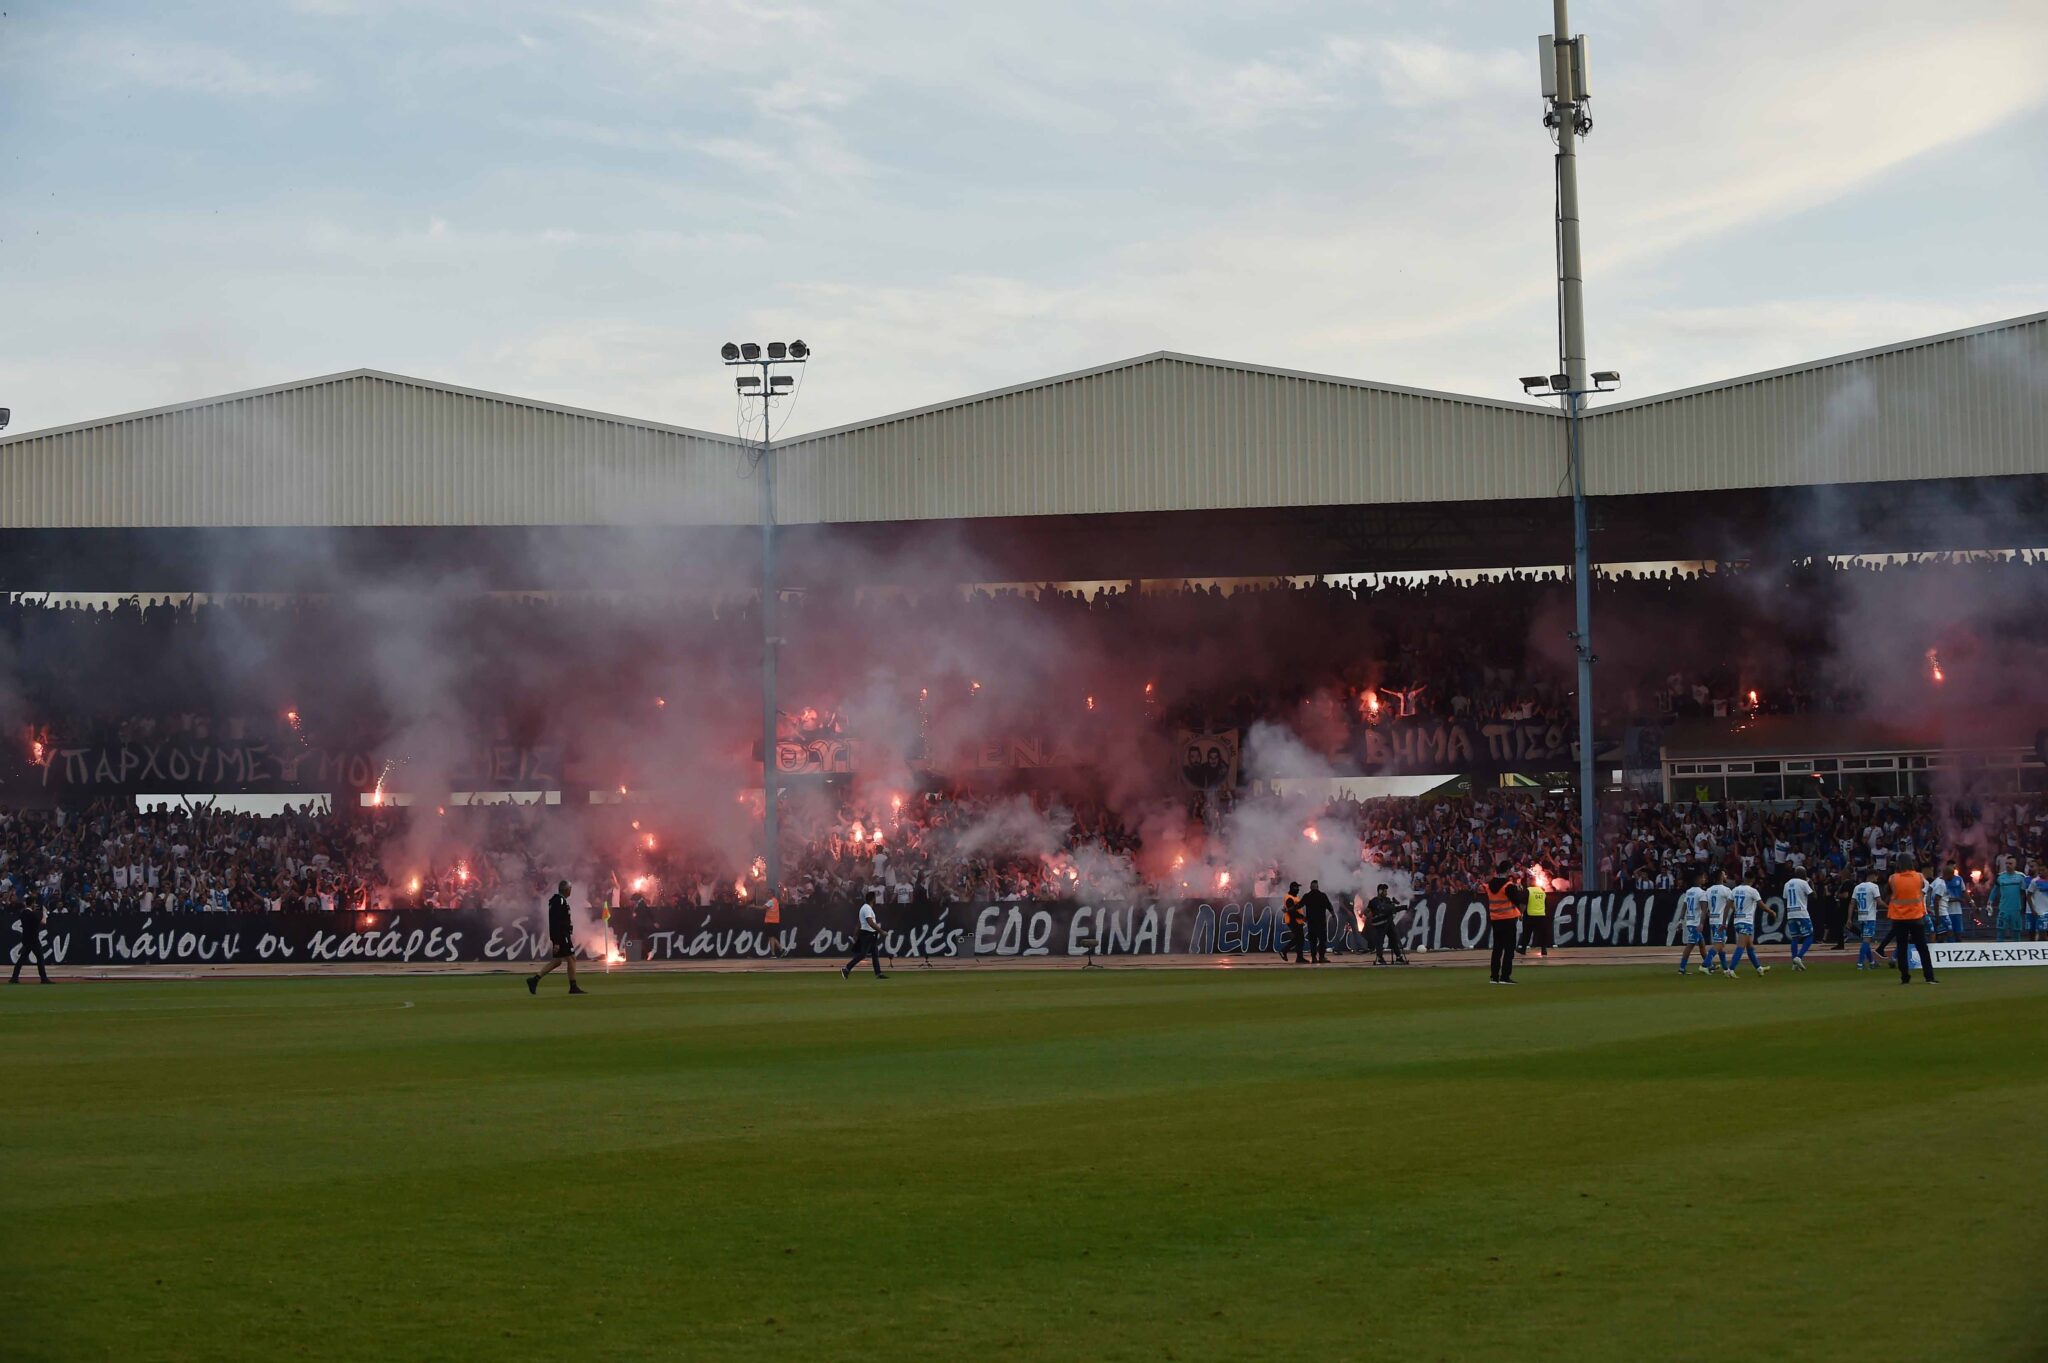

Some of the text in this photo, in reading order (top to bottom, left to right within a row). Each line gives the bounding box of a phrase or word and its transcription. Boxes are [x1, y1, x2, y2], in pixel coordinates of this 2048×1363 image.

[1365, 726, 1474, 766] ΒΗΜΑ
[974, 905, 1052, 956] ΕΔΩ
[1068, 904, 1176, 956] ΕΙΝΑΙ
[1553, 894, 1655, 946] ΕΙΝΑΙ
